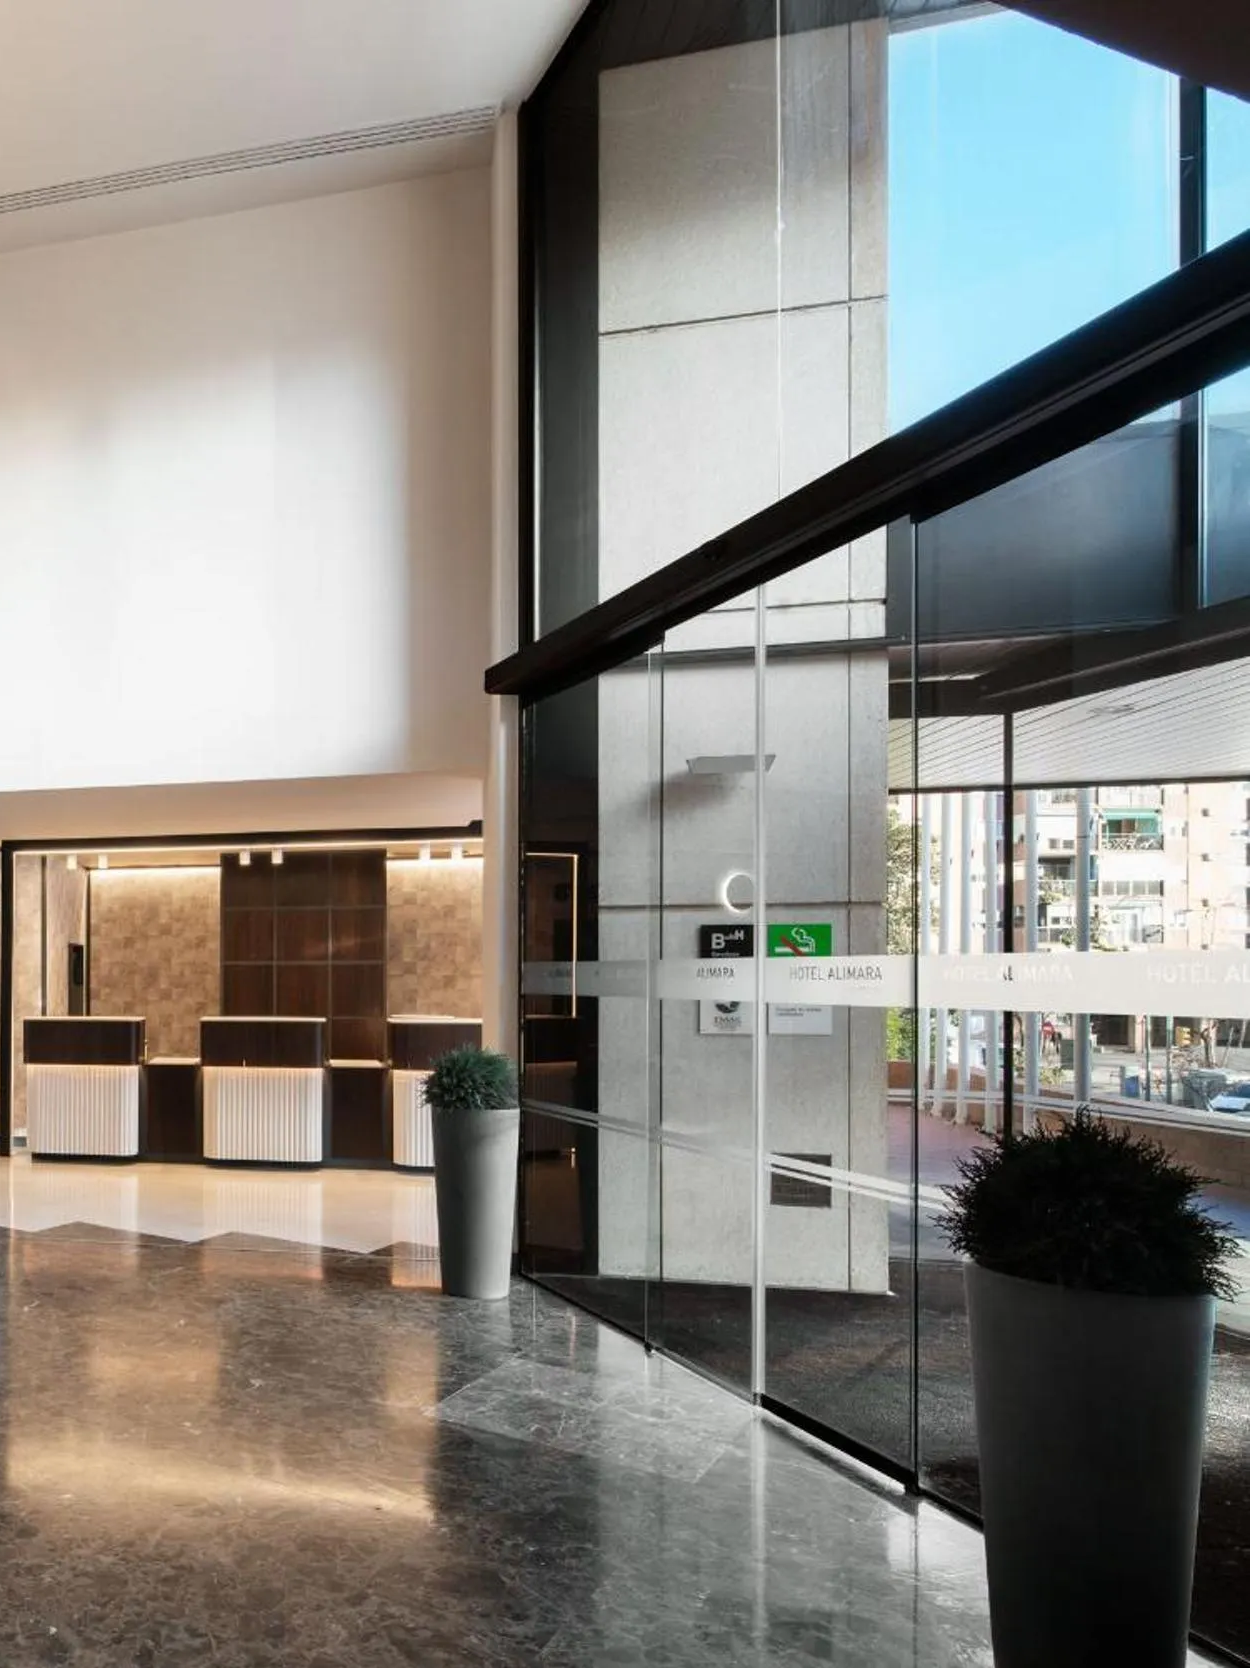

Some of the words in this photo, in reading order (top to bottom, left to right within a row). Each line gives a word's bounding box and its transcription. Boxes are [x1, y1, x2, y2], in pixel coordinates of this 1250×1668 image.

[790, 966, 826, 981] HOTEL
[828, 966, 883, 981] ALIMARA
[1147, 964, 1216, 984] HOTEL
